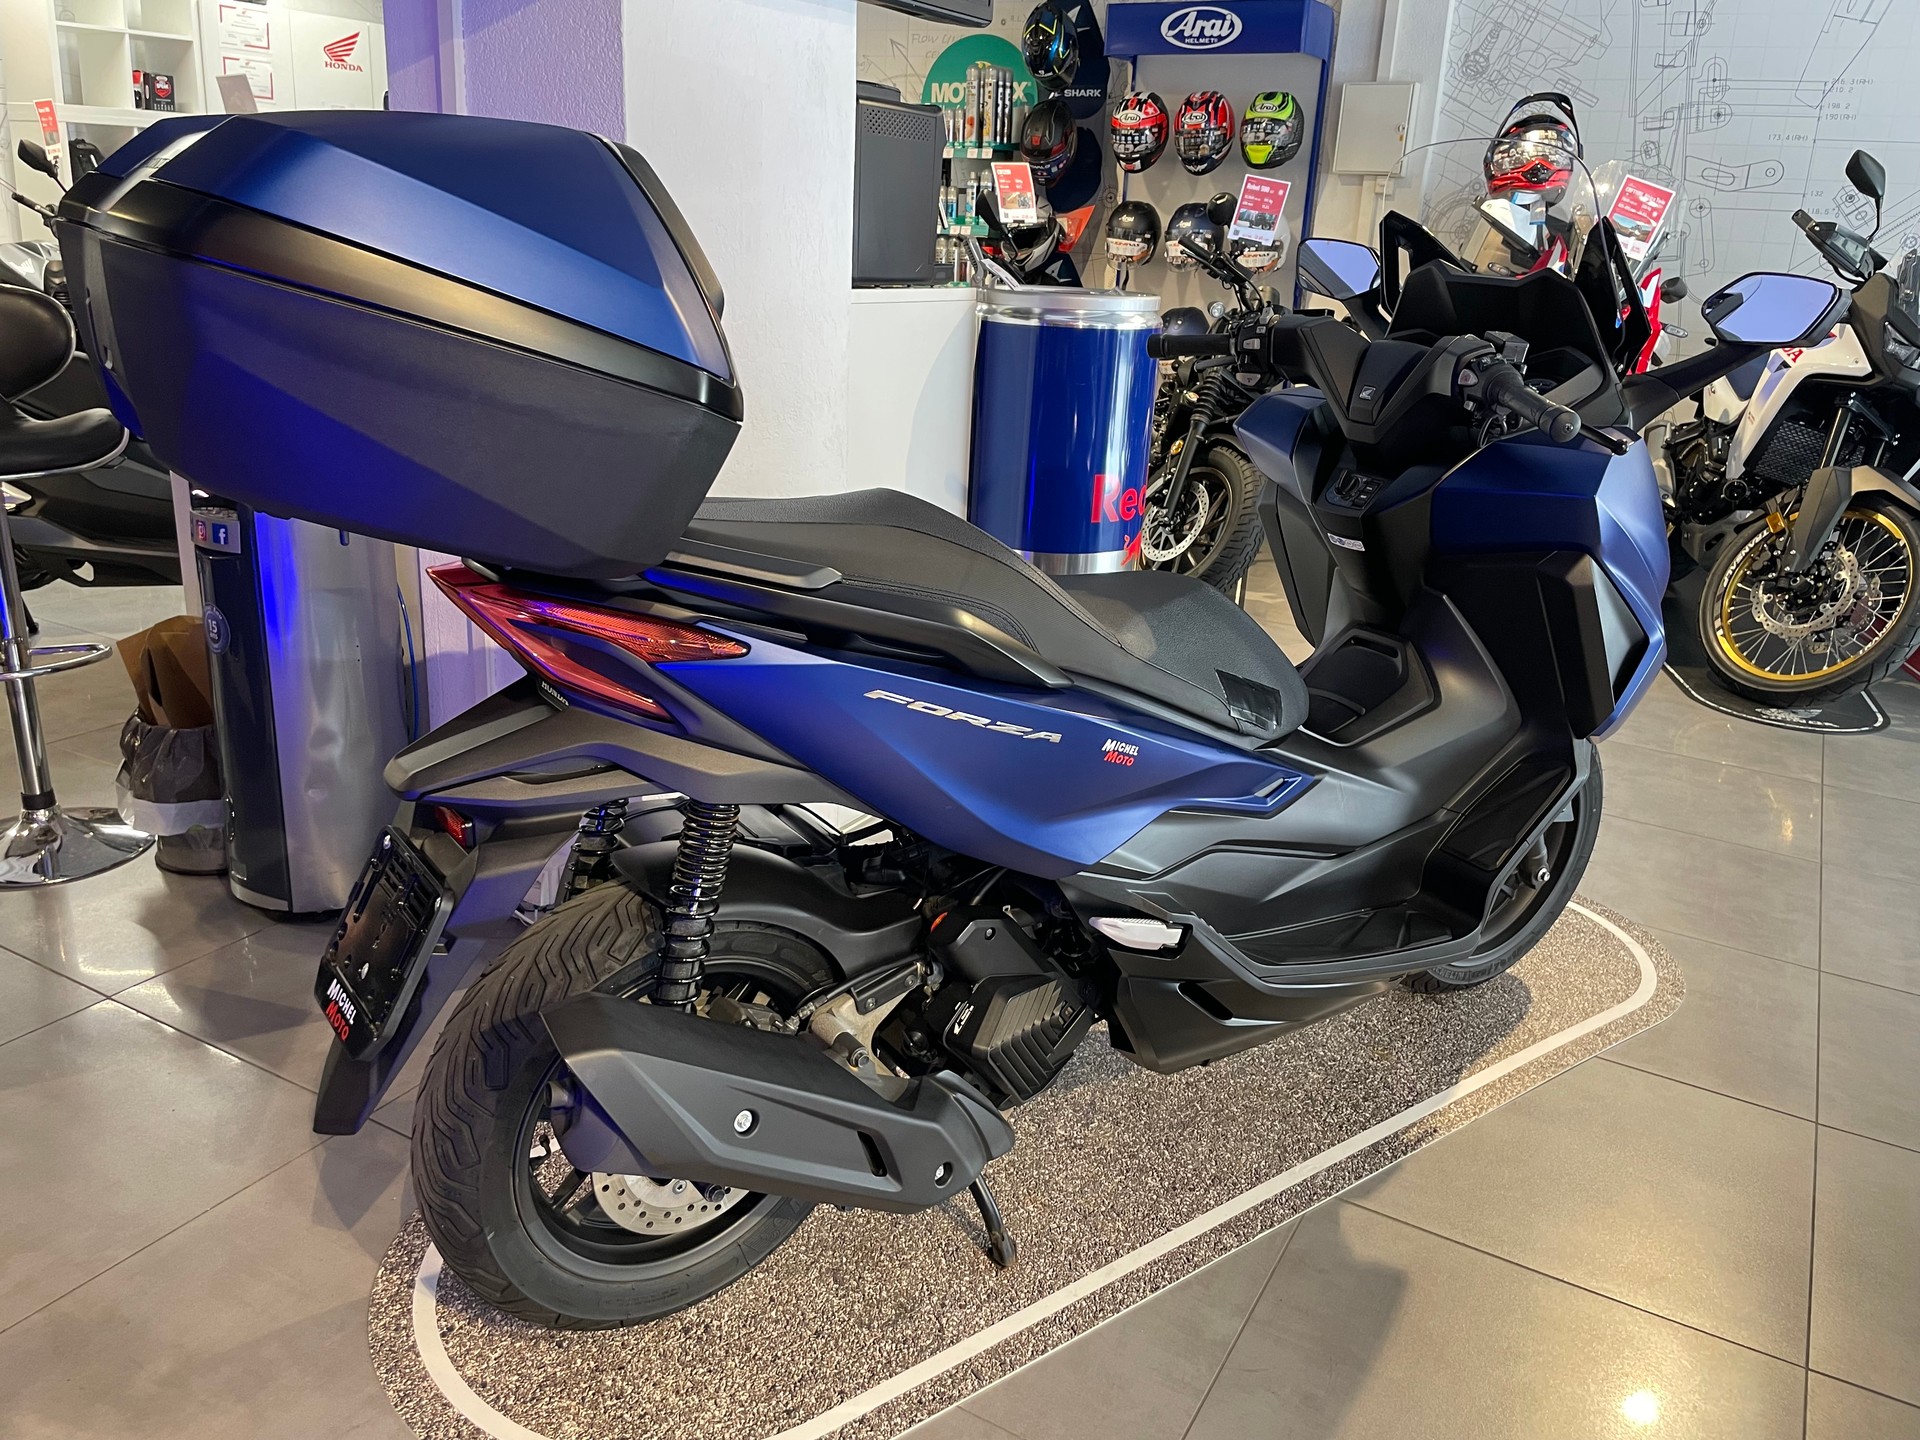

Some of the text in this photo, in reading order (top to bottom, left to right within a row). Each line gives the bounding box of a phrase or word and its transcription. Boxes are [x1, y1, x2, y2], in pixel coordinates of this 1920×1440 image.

[1166, 11, 1233, 37] Arai
[324, 60, 364, 73] HONDA
[1063, 88, 1102, 98] SHARK
[1121, 113, 1139, 122] Arai
[1185, 112, 1206, 123] Arai
[863, 689, 1063, 743] FORZA
[1101, 738, 1139, 757] MICHEL
[1103, 750, 1135, 767] MOTO
[326, 978, 357, 1026] MICHEL
[325, 1001, 350, 1042] MOTO
